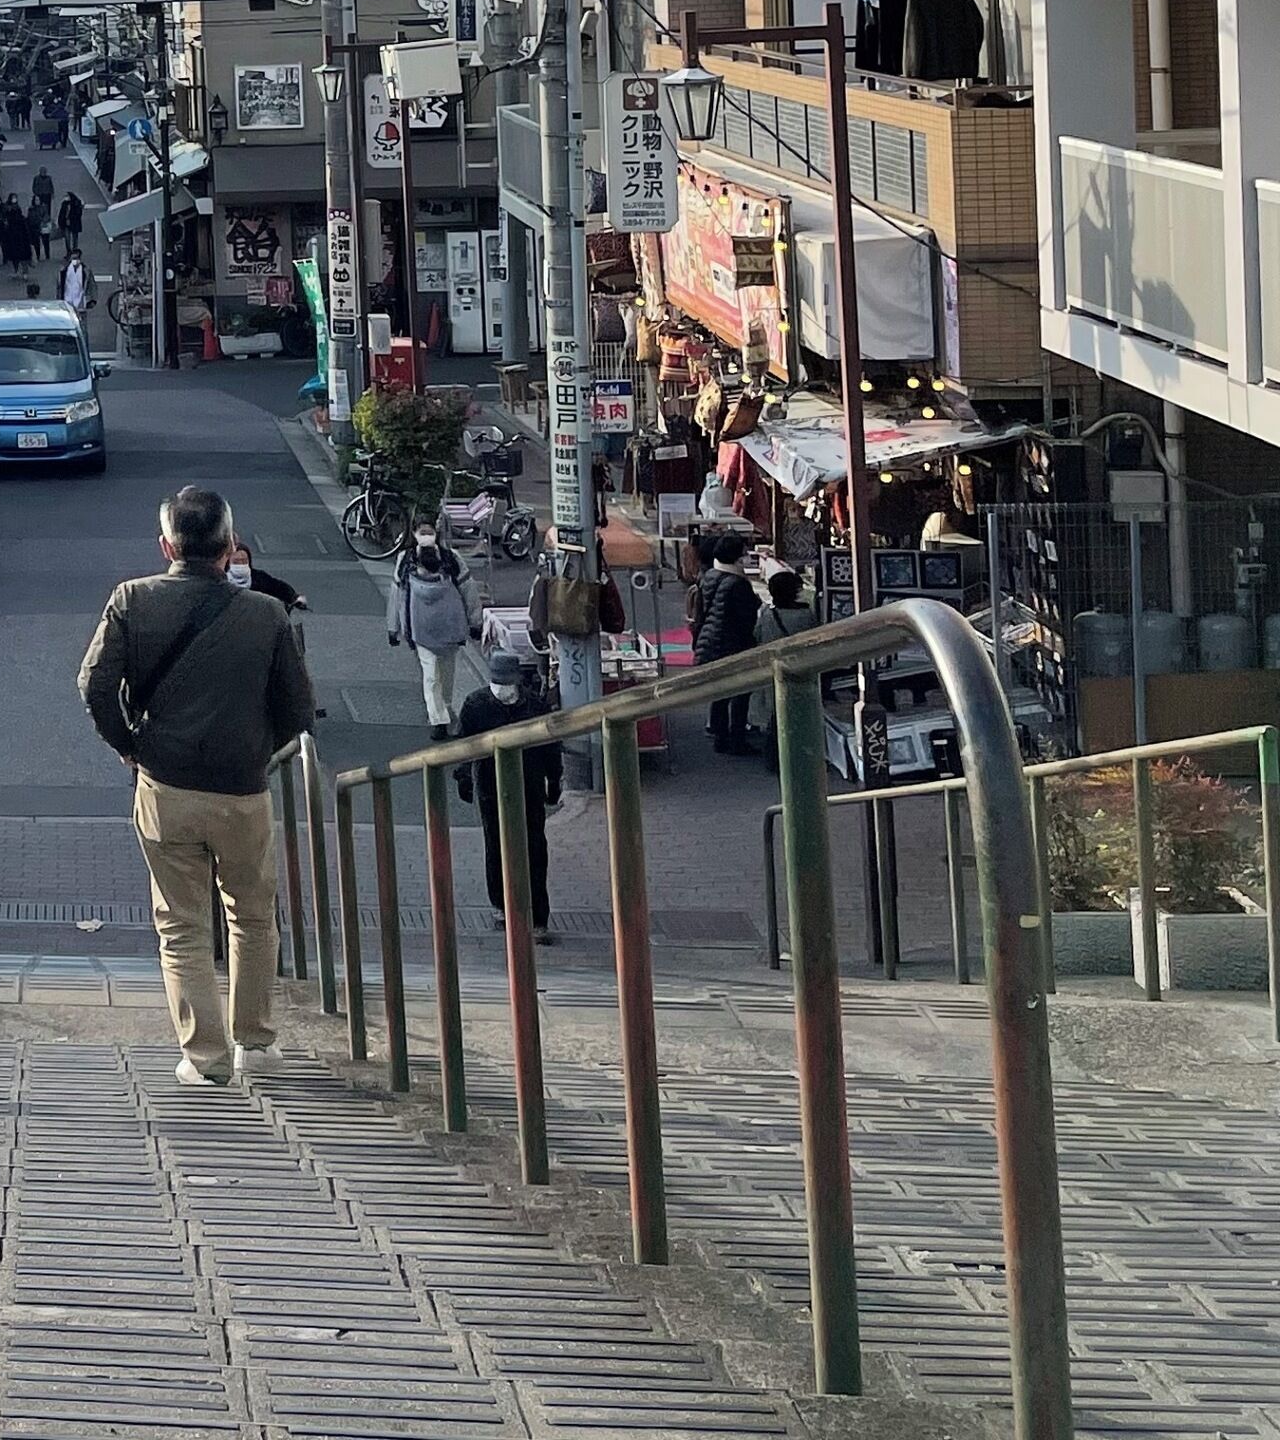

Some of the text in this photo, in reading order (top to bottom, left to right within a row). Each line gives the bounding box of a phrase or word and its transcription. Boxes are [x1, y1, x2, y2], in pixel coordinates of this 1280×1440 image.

[621, 113, 641, 198] クリニック
[641, 113, 664, 199] 動物・野沢
[556, 384, 577, 429] 田戸
